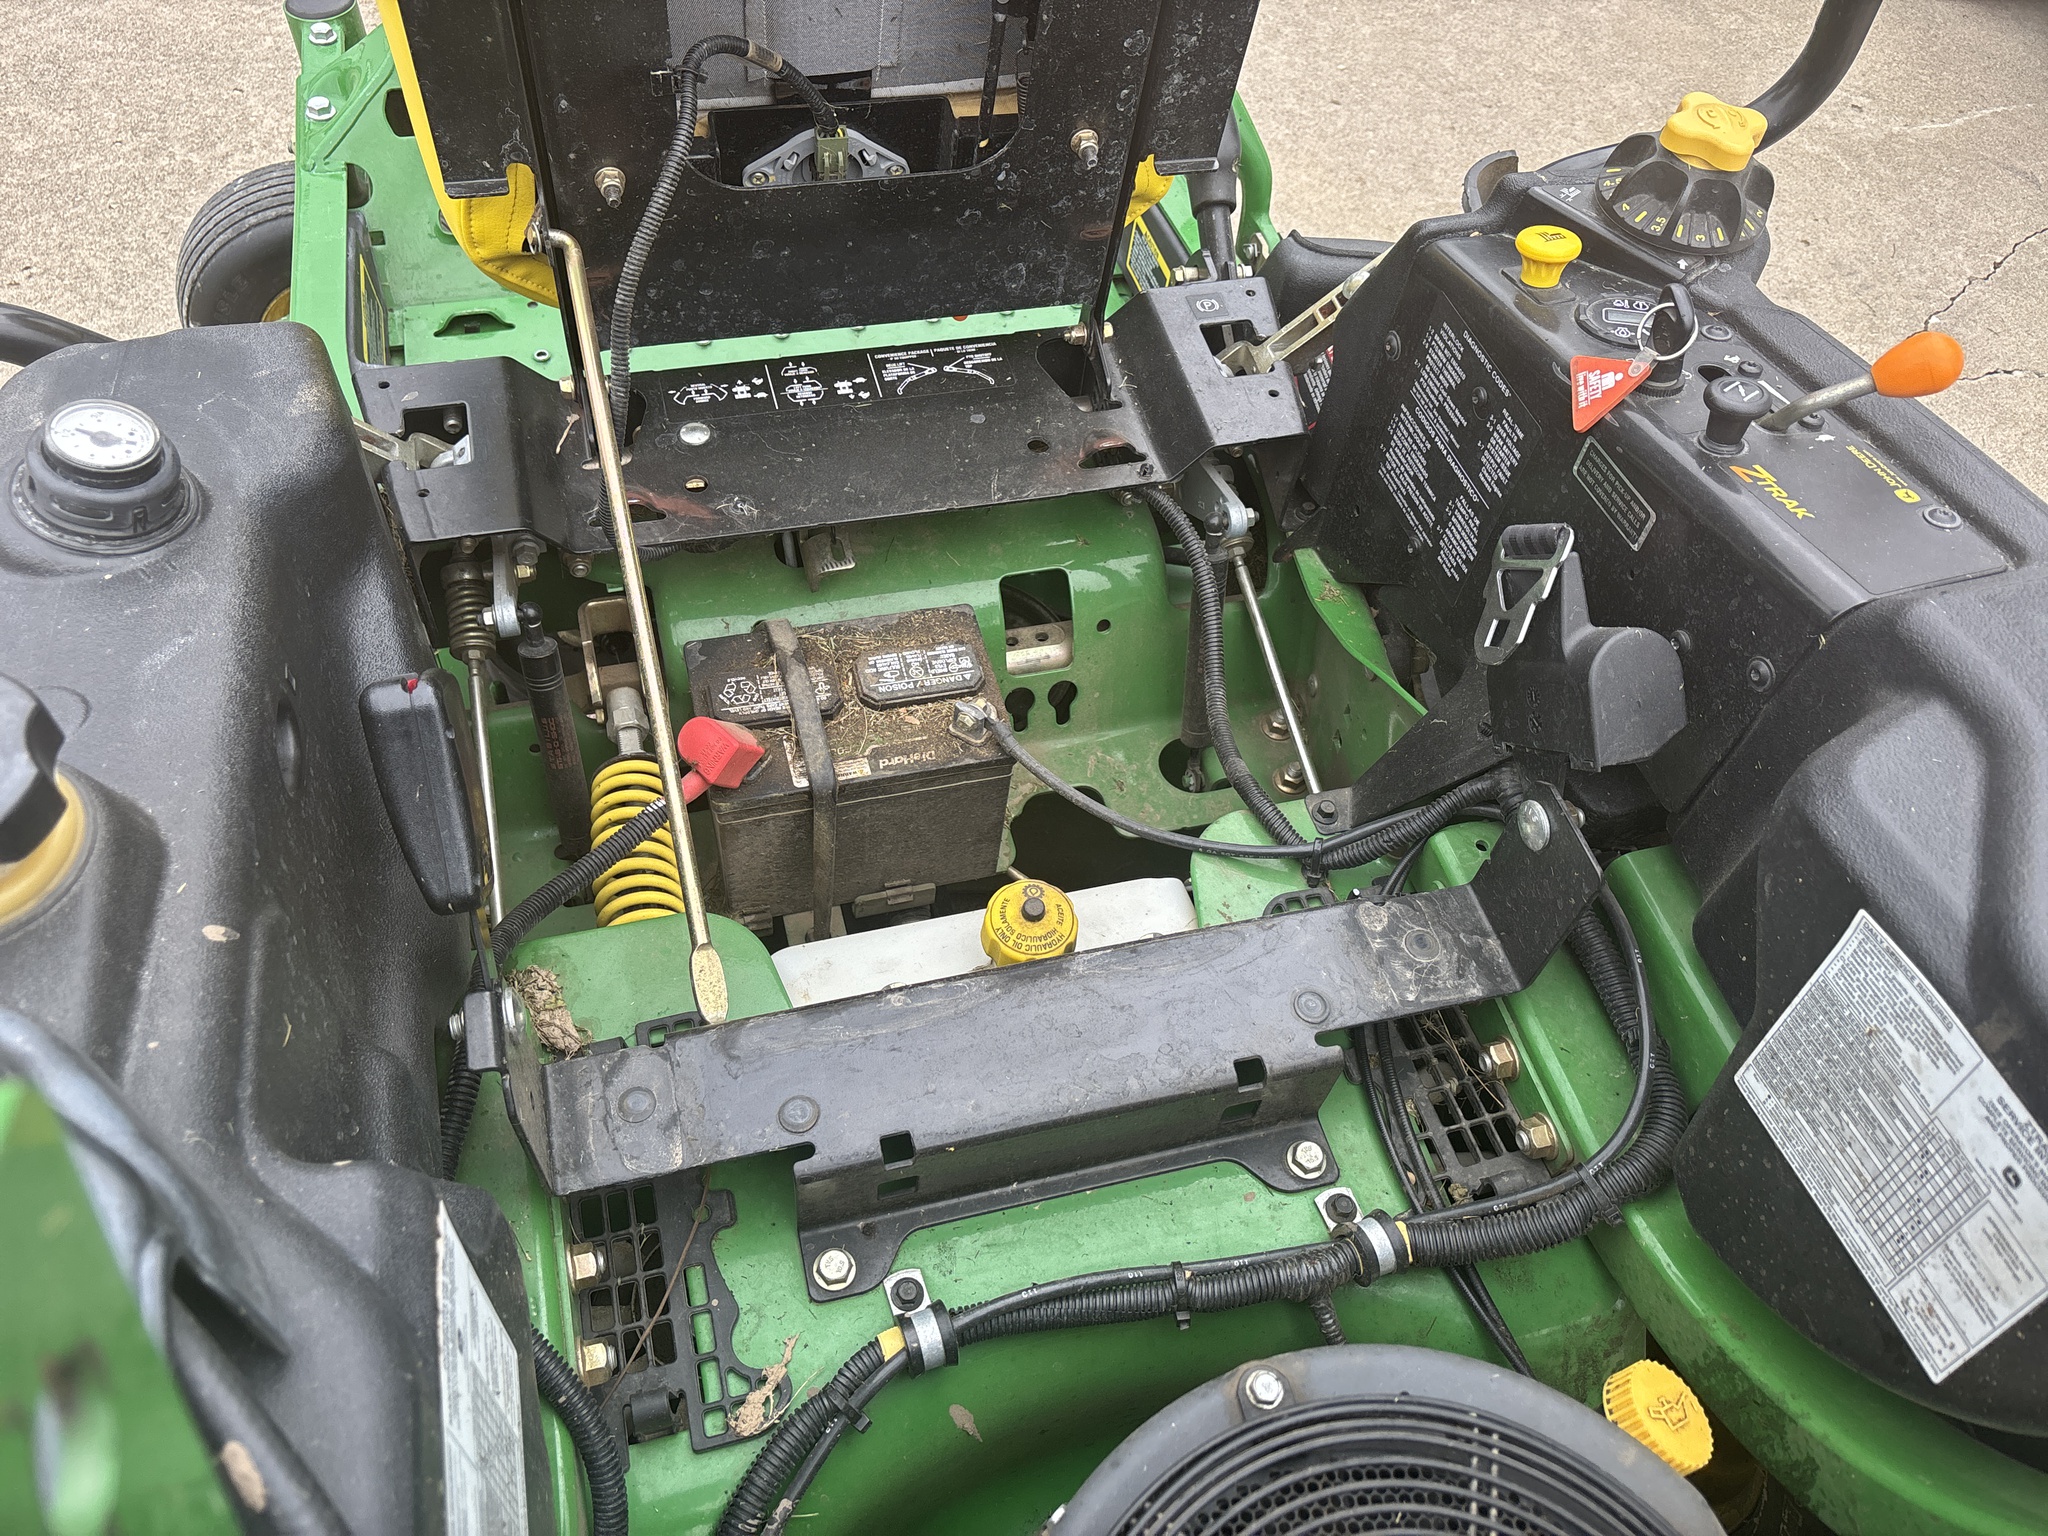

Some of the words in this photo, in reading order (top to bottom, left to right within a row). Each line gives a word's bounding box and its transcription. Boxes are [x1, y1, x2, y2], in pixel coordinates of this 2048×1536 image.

[1651, 216, 1666, 232] 3.5
[1695, 234, 1705, 242] 3
[961, 341, 997, 349] CONVENIENCIA
[1439, 327, 1461, 361] VIOLATIONS
[1442, 320, 1464, 354] INTERLOCK
[1462, 329, 1492, 373] DIAGNOSTIC
[1589, 369, 1602, 400] SAFETY
[1414, 405, 1436, 438] CODIGOS
[1434, 435, 1448, 456] PARA
[1501, 407, 1524, 441] REAL-TIME
[1501, 418, 1517, 443] FAULTS
[1489, 435, 1496, 446] OR
[1495, 443, 1510, 467] STARTER
[1492, 430, 1503, 447] WEAK
[1502, 443, 1518, 468] BATTERY
[1495, 422, 1506, 439] OVER
[1505, 436, 1521, 460] VOLTAGE
[1846, 446, 1875, 469] DEERE
[1480, 454, 1498, 481] DETECTED
[1483, 448, 1498, 471] OUTPUT
[1496, 467, 1508, 486] FAULT
[1486, 442, 1501, 464] SYSTEM
[1499, 460, 1511, 478] ISSUE
[1481, 465, 1492, 482] Check
[1490, 479, 1502, 499] Engine
[1585, 458, 1604, 483] DELIVERY
[1602, 479, 1612, 493] AND
[1610, 490, 1628, 513] SERVICE
[1626, 509, 1640, 529] CALLS
[1588, 448, 1607, 473] CHARGES
[1605, 469, 1615, 483] FOR
[1614, 480, 1631, 502] PICK-UP
[1629, 498, 1646, 521] AND/OR
[1872, 467, 1902, 489] JOHN
[1453, 496, 1469, 521] TIEMPO
[1467, 517, 1479, 537] REAL
[1459, 494, 1474, 518] FALLAS
[1473, 515, 1480, 527] DE
[1578, 463, 1587, 476] ARE
[1585, 473, 1595, 486] NOT
[1593, 483, 1612, 508] COVERED
[1610, 504, 1617, 515] BY
[1615, 511, 1638, 542] WARRANTY
[877, 681, 914, 692] POISON
[923, 674, 962, 685] DANGER
[701, 742, 730, 775] WARNING
[879, 750, 937, 770] DieHard
[1000, 897, 1016, 936] SOLAMENTE
[1055, 903, 1065, 927] ACEITE
[995, 927, 1011, 943] ONLY
[1012, 939, 1023, 950] OIL
[1016, 927, 1059, 943] HIDRAULICO
[1025, 932, 1066, 952] HYDRAULIC
[1862, 919, 1884, 947] DAILY
[1884, 943, 1916, 984] SERVICE
[1914, 981, 1955, 1031] REQUIRED
[1819, 978, 1847, 1014] PERIODIC
[1846, 1012, 1872, 1046] SERVICE
[1869, 1044, 1902, 1087] REQUIRED
[1995, 1095, 2034, 1148] SERVICE
